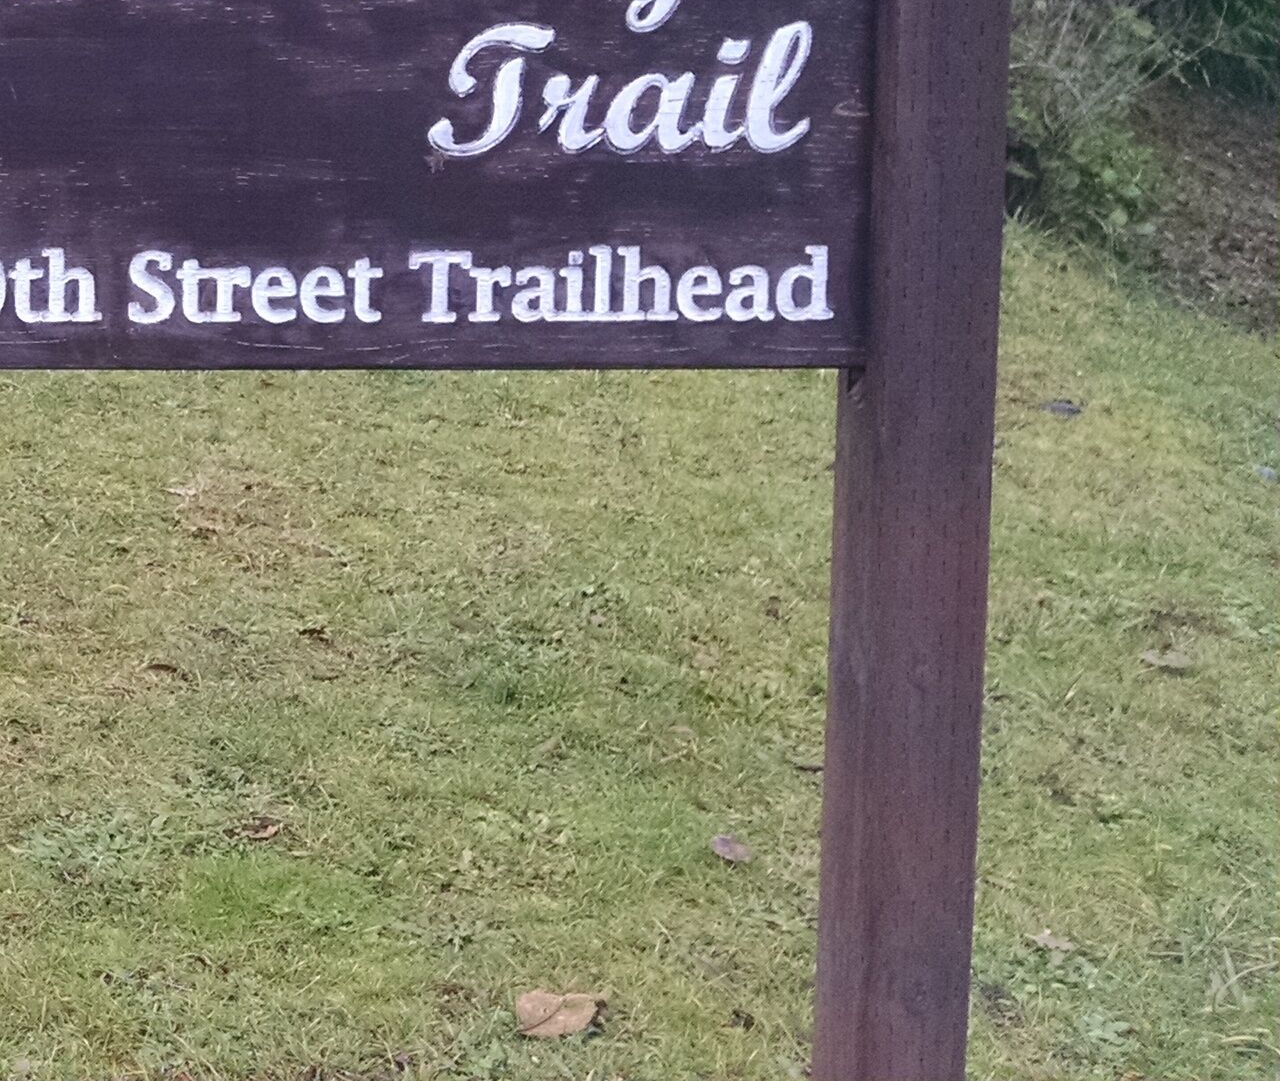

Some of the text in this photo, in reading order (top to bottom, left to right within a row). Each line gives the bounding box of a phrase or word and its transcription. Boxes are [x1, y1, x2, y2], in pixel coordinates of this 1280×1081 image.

[428, 21, 813, 157] Trail
[127, 249, 384, 325] Street
[408, 244, 835, 324] Trailhead
